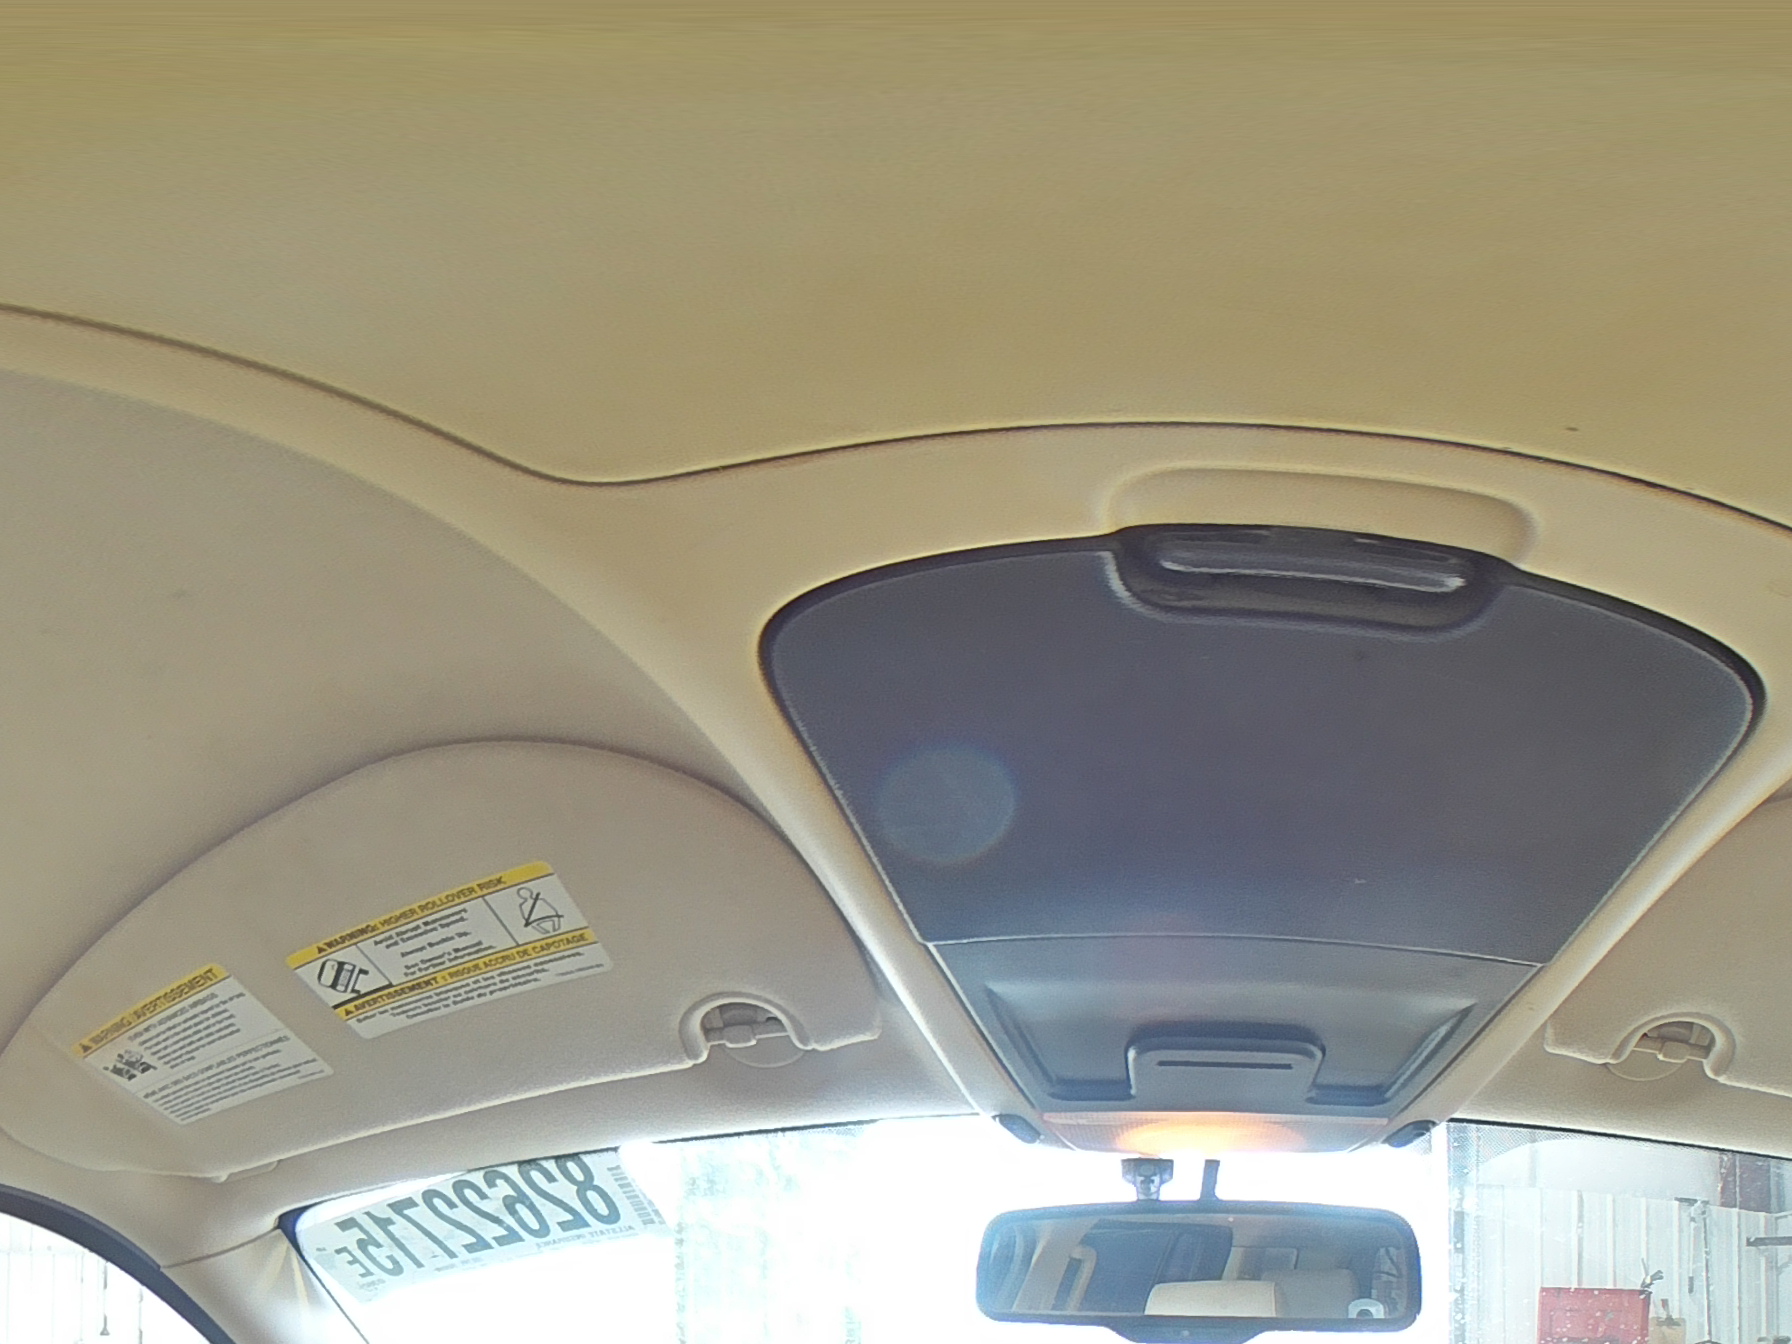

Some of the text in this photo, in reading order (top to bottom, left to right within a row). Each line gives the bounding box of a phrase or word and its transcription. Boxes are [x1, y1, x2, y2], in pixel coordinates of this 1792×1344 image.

[379, 907, 418, 928] HIGHER
[417, 886, 477, 913] ROLLOVER
[476, 875, 507, 891] RISK
[354, 976, 439, 1010] AVERTISSEMENT
[448, 963, 483, 980] RISQUE
[483, 954, 516, 968] ACCRU
[516, 946, 532, 958] DE
[532, 932, 587, 954] CAPOTAGE
